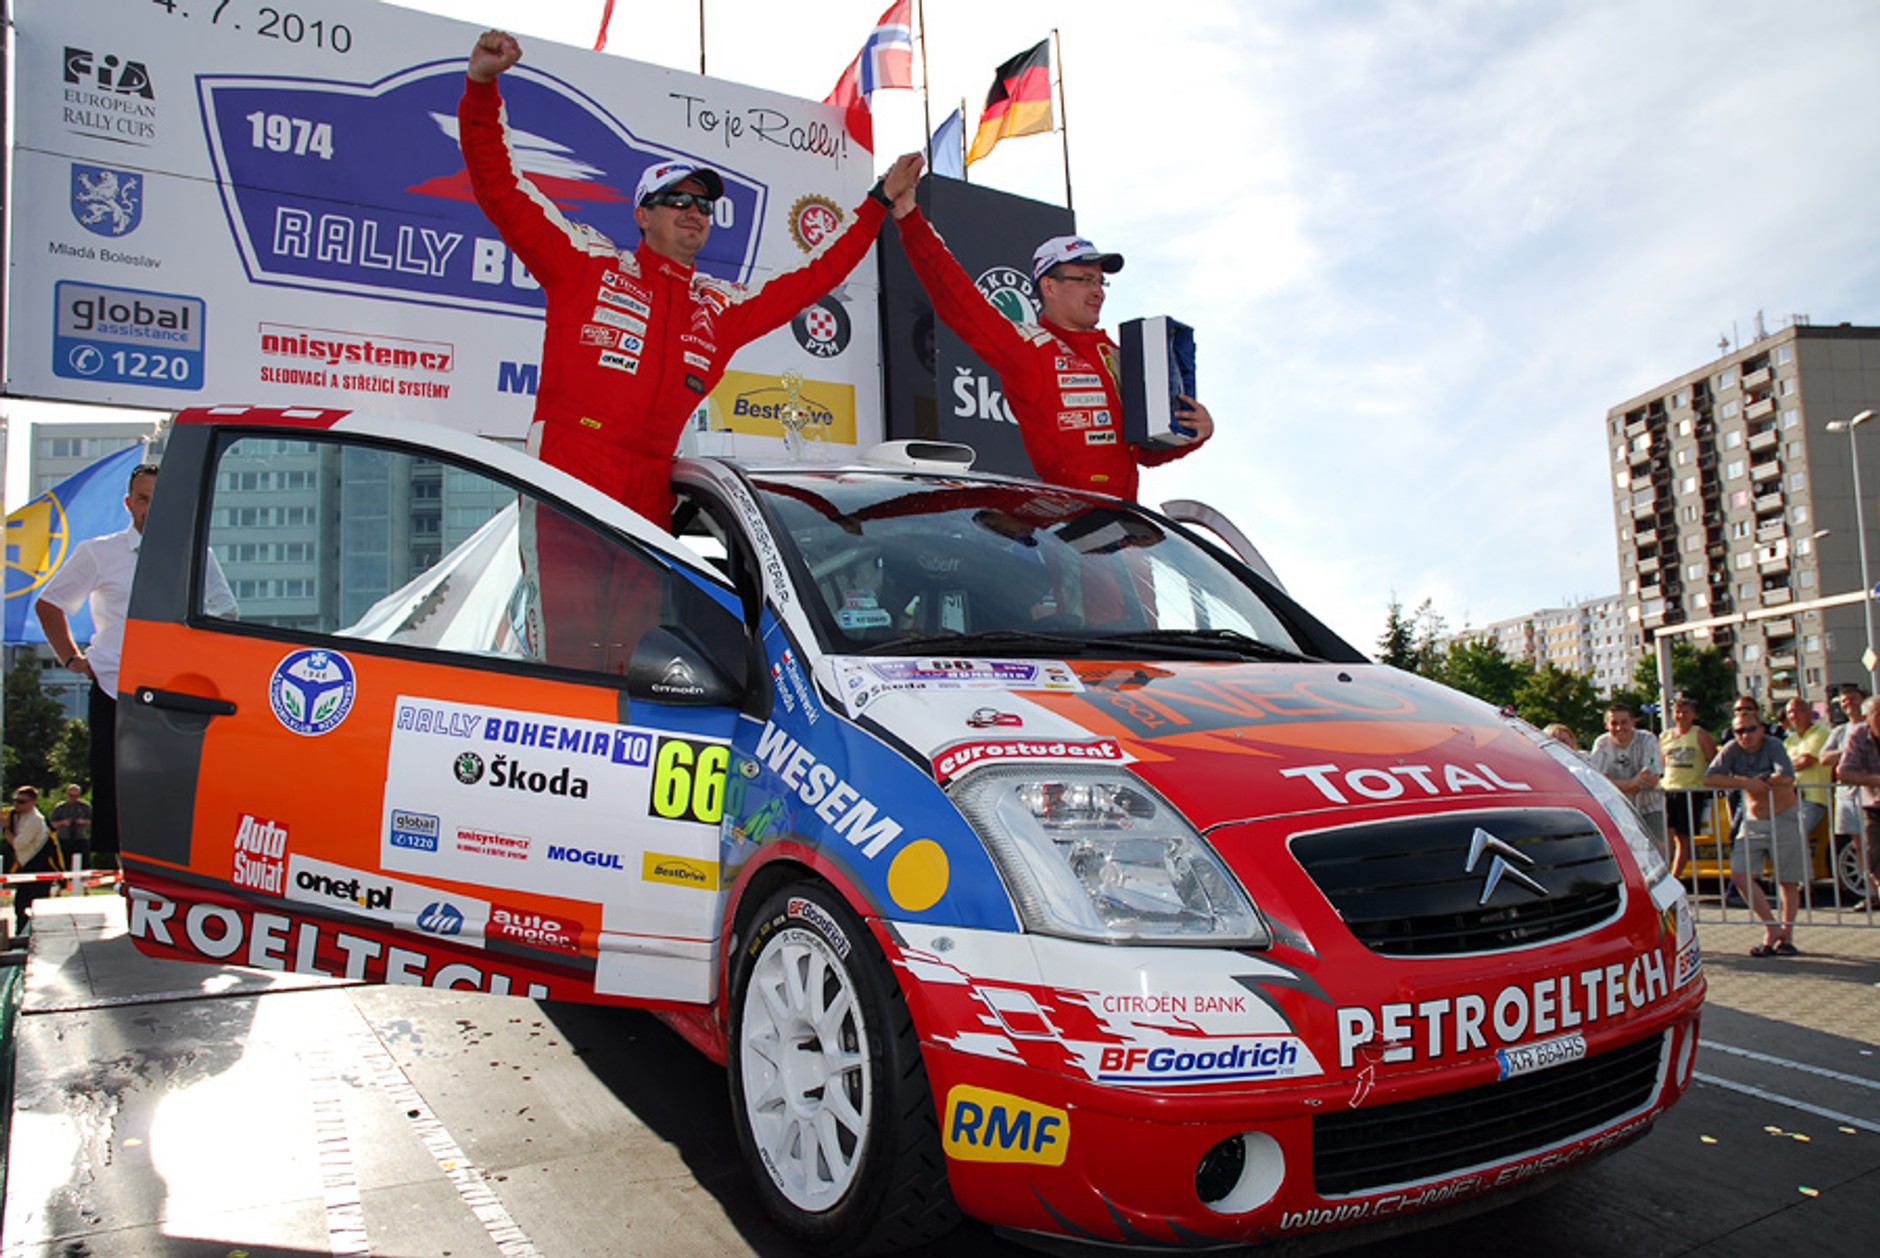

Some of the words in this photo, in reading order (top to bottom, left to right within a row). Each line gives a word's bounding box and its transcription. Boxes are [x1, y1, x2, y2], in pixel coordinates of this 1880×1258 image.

[257, 7, 352, 53] 2010
[64, 88, 156, 118] EUROPEAN
[63, 106, 112, 132] RALLY
[116, 118, 156, 139] CUPS
[247, 111, 334, 160] 1974
[48, 240, 96, 260] Mladá
[100, 248, 162, 269] Boleslav
[273, 206, 463, 277] RALLY
[71, 296, 190, 331] global
[97, 323, 190, 343] assistance
[805, 338, 840, 358] PZM
[111, 350, 190, 382] 1220
[330, 373, 339, 389] A
[396, 705, 482, 739] RALLY
[484, 717, 610, 757] BOHEMIA
[616, 729, 649, 764] '10
[939, 741, 1116, 775] eurostudent
[488, 753, 588, 800] Škoda
[653, 739, 731, 824] 66
[755, 719, 904, 860] WESEM
[1279, 762, 1533, 804] TOTAL
[234, 814, 288, 859] Auto
[396, 814, 436, 829] global
[407, 835, 434, 850] 1220
[547, 845, 624, 870] MOGUL
[653, 864, 708, 883] BestDrive
[296, 870, 394, 911] onet.pl
[492, 909, 562, 932] auto
[502, 923, 571, 945] motor
[788, 899, 850, 956] BFGoodrich
[1103, 991, 1188, 1013] CITROËN
[1194, 997, 1247, 1013] BANK
[1336, 948, 1670, 1068] PETROELTECH
[1098, 1040, 1298, 1073] BFGoodrich
[951, 1100, 1062, 1154] RMF
